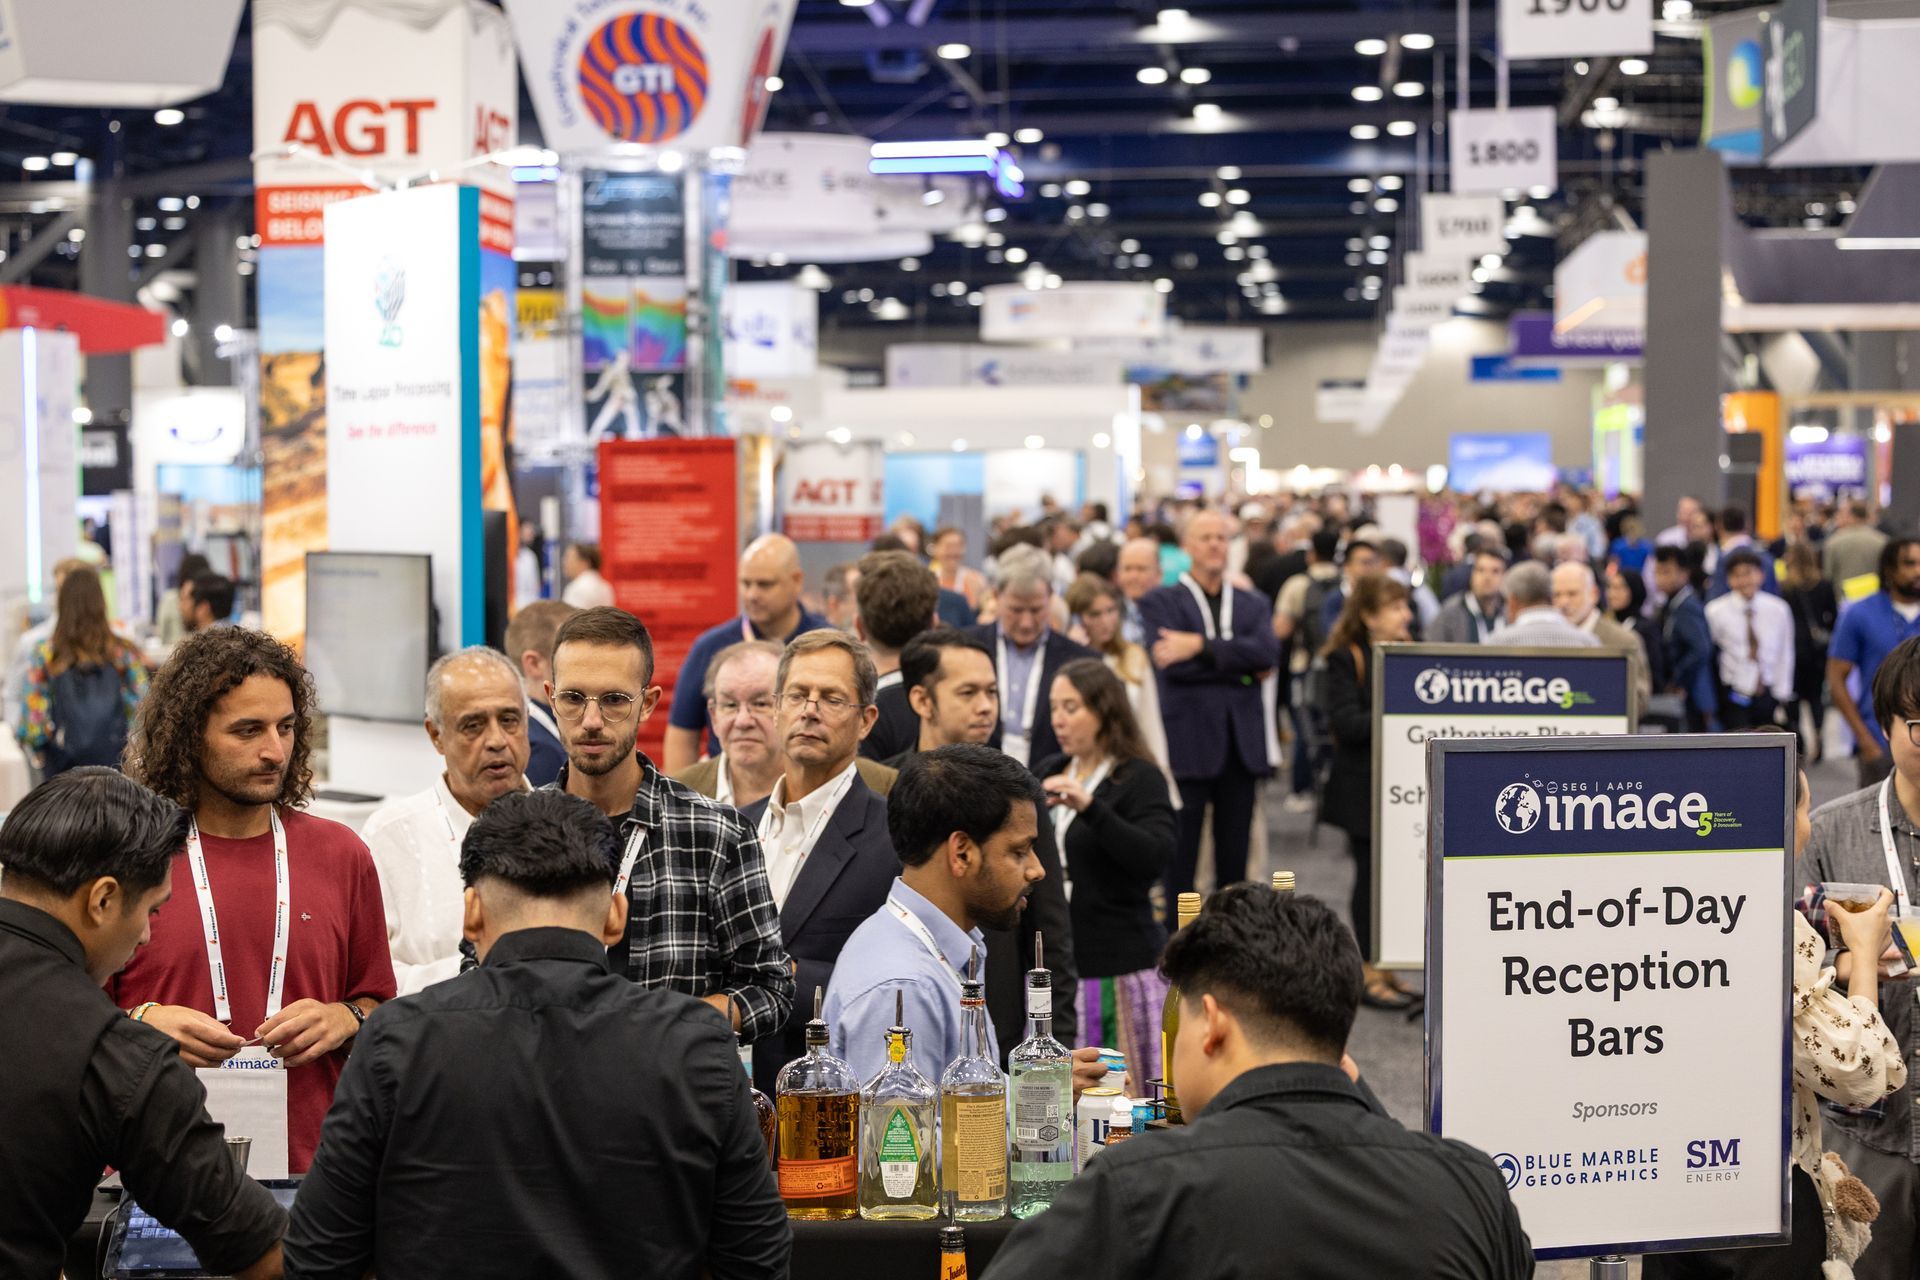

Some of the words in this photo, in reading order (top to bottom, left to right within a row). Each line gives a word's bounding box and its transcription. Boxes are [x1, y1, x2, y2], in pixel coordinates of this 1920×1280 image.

[612, 63, 675, 95] GTI
[284, 100, 437, 157] AGT
[1467, 138, 1538, 165] 1800
[793, 479, 858, 505] AGT
[1450, 677, 1571, 704] image
[1560, 692, 1574, 709] 5
[1562, 782, 1587, 791] SEG
[1607, 781, 1643, 790] AAPG
[1545, 791, 1708, 831] image
[1696, 812, 1713, 837] 5
[208, 906, 216, 931] resources
[1487, 886, 1747, 934] End-of-Day
[1502, 950, 1730, 1001] Reception
[1567, 1018, 1664, 1057] Bars
[235, 1059, 279, 1069] image
[1571, 1101, 1658, 1122] Sponsors
[1525, 1153, 1572, 1170] BLUE
[1582, 1148, 1659, 1167] MARBLE
[1686, 1138, 1741, 1169] SM
[1525, 1168, 1659, 1187] GEOGRAPHICS
[1686, 1171, 1741, 1183] ENERGY
